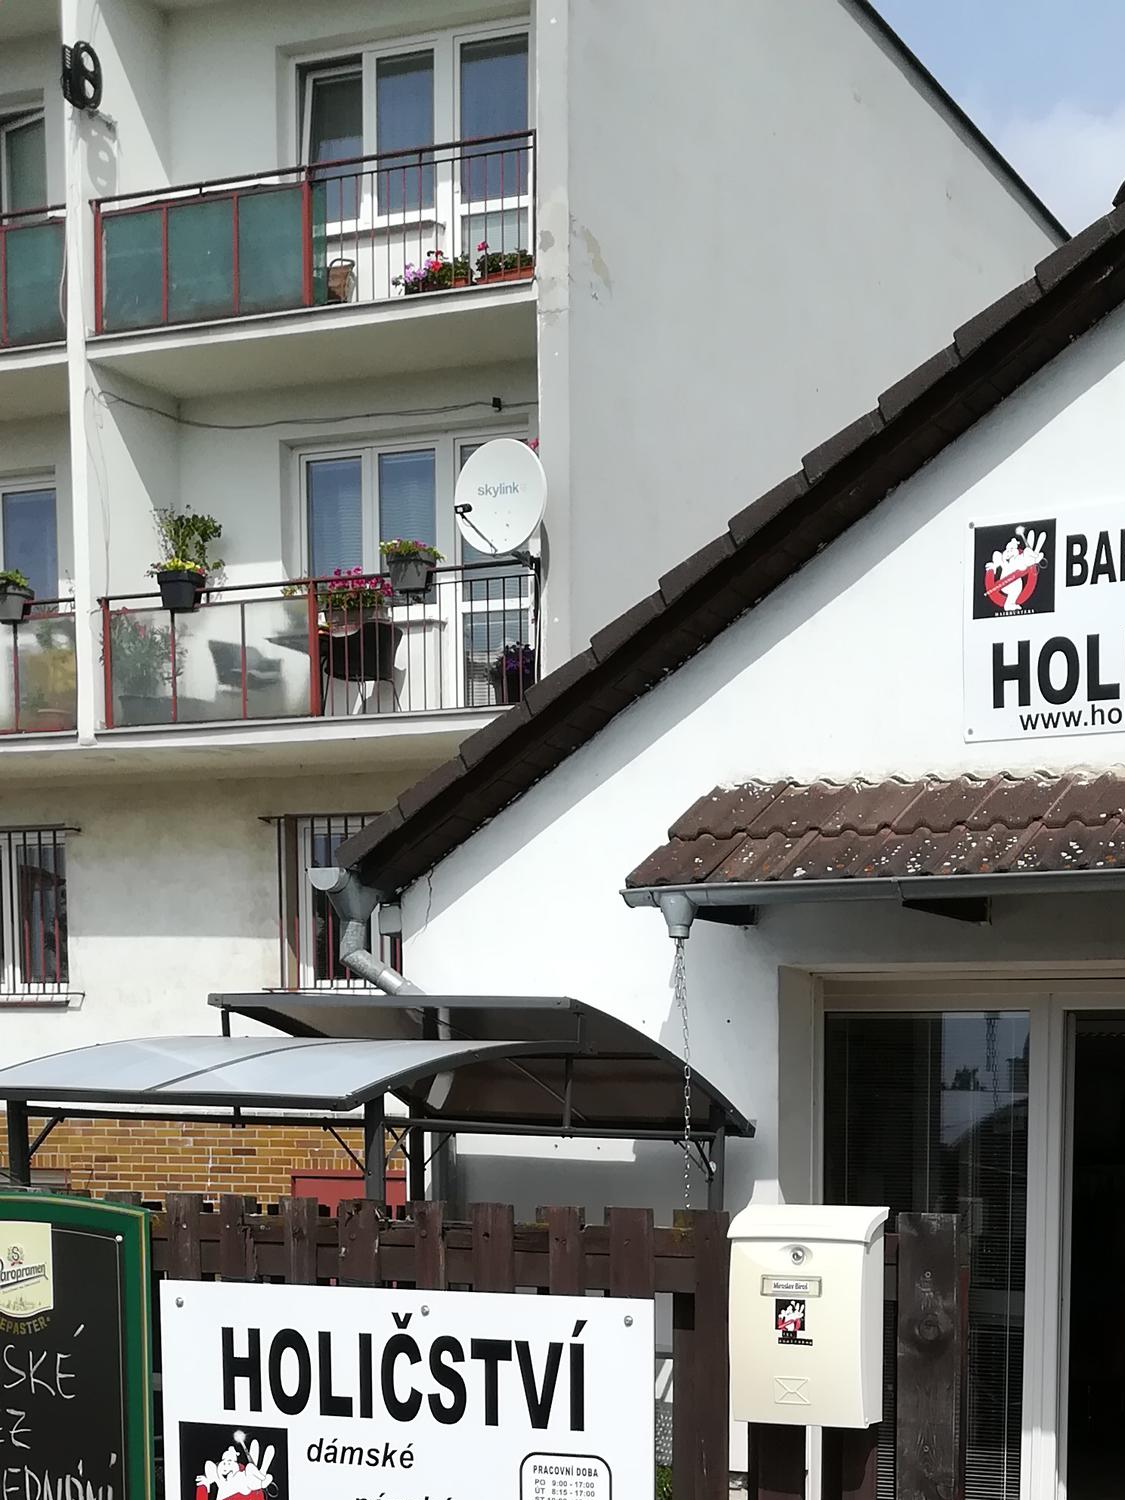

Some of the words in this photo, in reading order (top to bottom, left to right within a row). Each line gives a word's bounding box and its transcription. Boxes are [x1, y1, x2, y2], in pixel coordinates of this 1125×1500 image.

[478, 482, 520, 498] skylink
[221, 1311, 588, 1432] HOLIČSTVÍ
[306, 1438, 414, 1469] dámské
[533, 1465, 574, 1476] PRACOVNÍ
[576, 1467, 598, 1477] DOBA
[575, 1481, 595, 1489] 17:00
